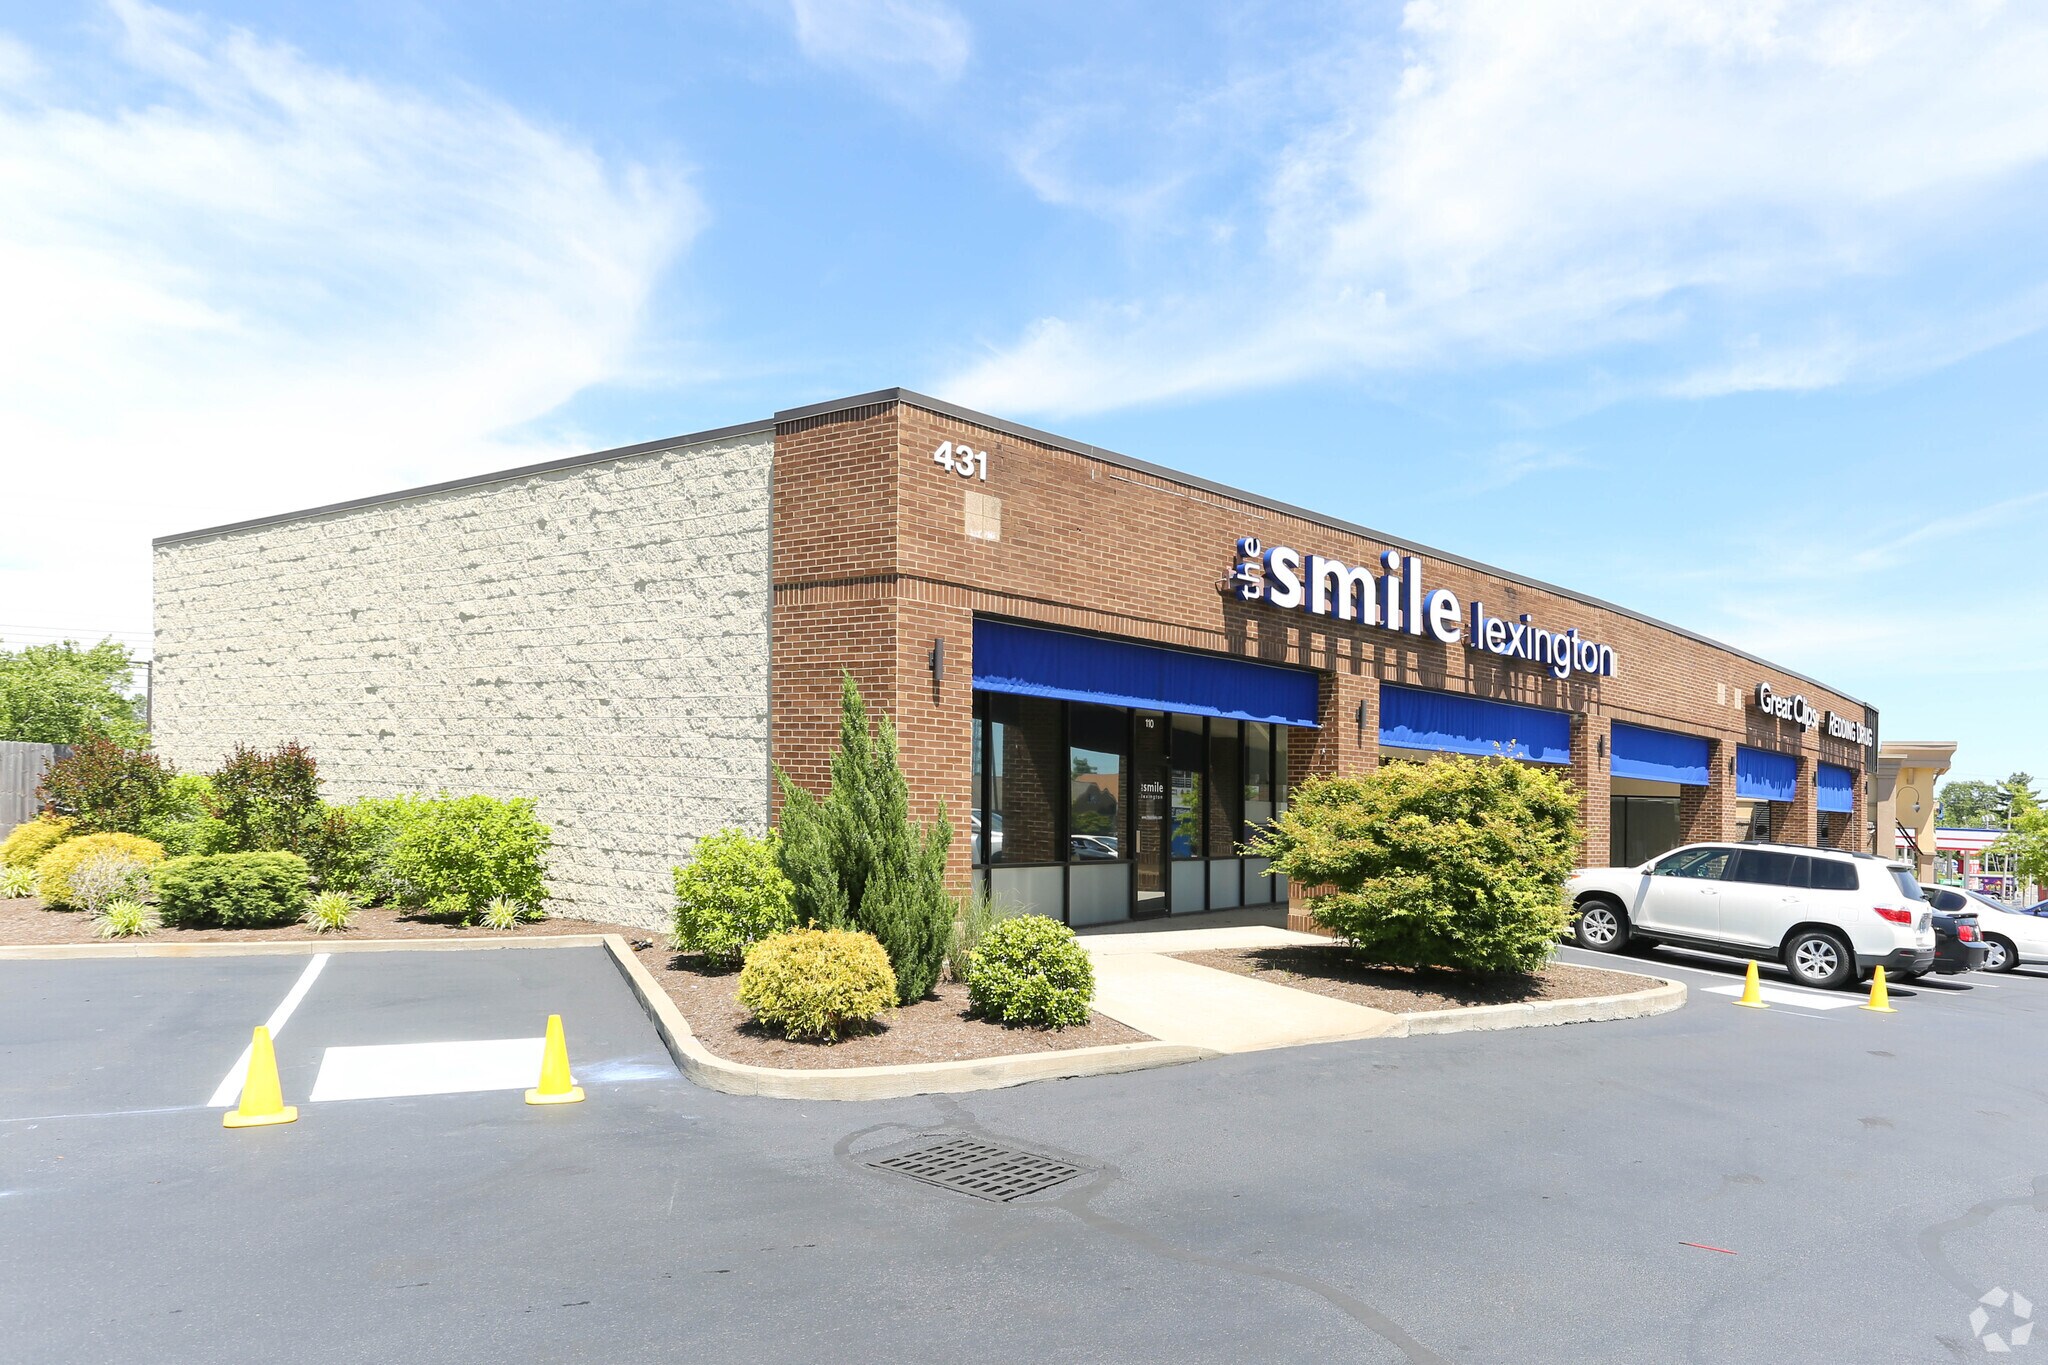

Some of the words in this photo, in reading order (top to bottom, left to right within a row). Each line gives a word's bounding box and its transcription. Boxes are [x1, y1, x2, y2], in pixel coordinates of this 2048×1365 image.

[933, 440, 988, 482] 431
[1238, 536, 1261, 601] the
[1265, 546, 1462, 643] smile
[1473, 601, 1617, 679] lexington
[1145, 718, 1155, 729] 110
[1758, 682, 1793, 720] Great
[1794, 695, 1819, 733] Clips
[1828, 711, 1857, 742] REDDING
[1856, 722, 1873, 747] DRUG
[1143, 781, 1164, 793] smile
